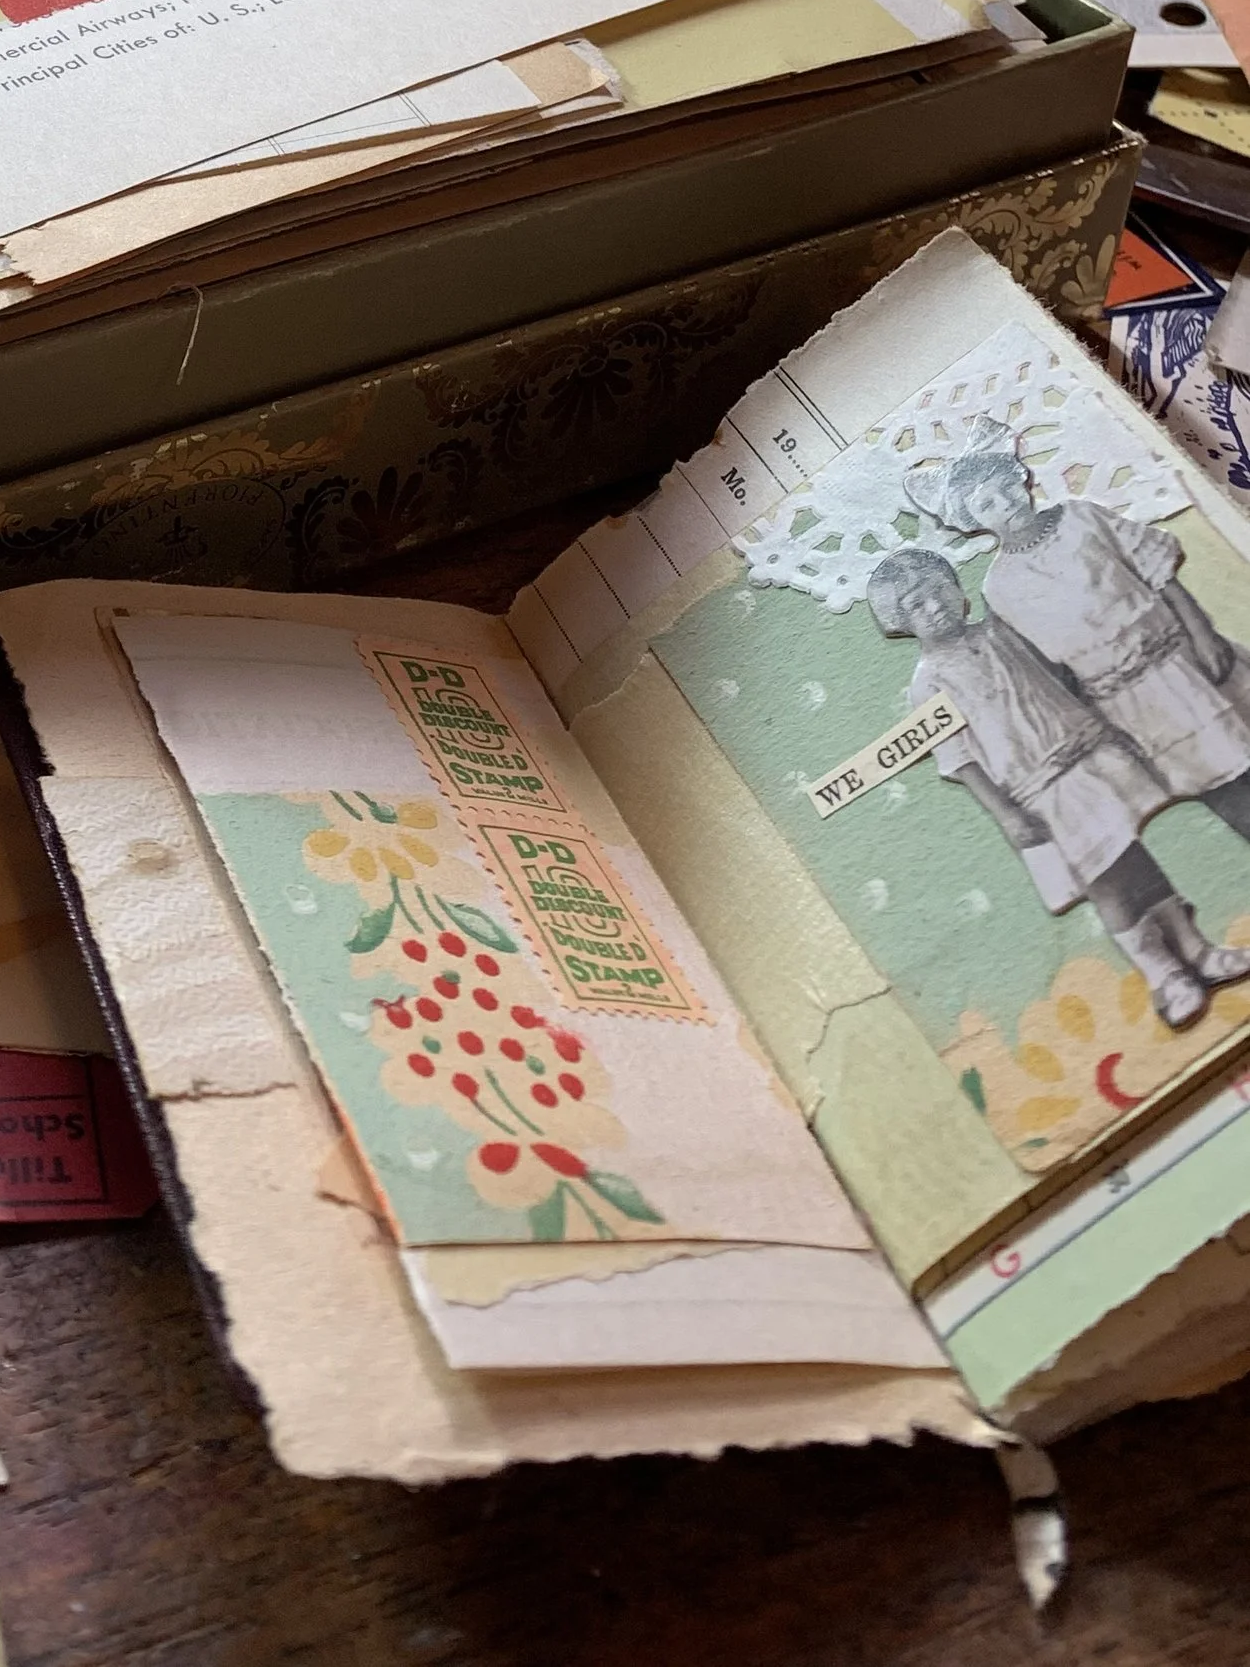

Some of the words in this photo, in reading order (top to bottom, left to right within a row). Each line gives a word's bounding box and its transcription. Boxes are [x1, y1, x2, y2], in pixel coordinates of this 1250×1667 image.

[77, 0, 177, 37] Airways;
[92, 32, 160, 61] Cities
[162, 20, 196, 40] of:
[720, 467, 747, 507] Mo.
[400, 659, 466, 689] D-D
[417, 699, 497, 722] DOUBLE
[418, 712, 513, 739] DISCOUNT
[814, 768, 867, 809] WE
[875, 704, 955, 772] GIRLS
[448, 761, 545, 795] STAMP
[507, 834, 577, 865] D-D
[528, 880, 610, 904] DOUBLE
[531, 896, 628, 922] DISCOUNT
[563, 954, 666, 990] STAMP
